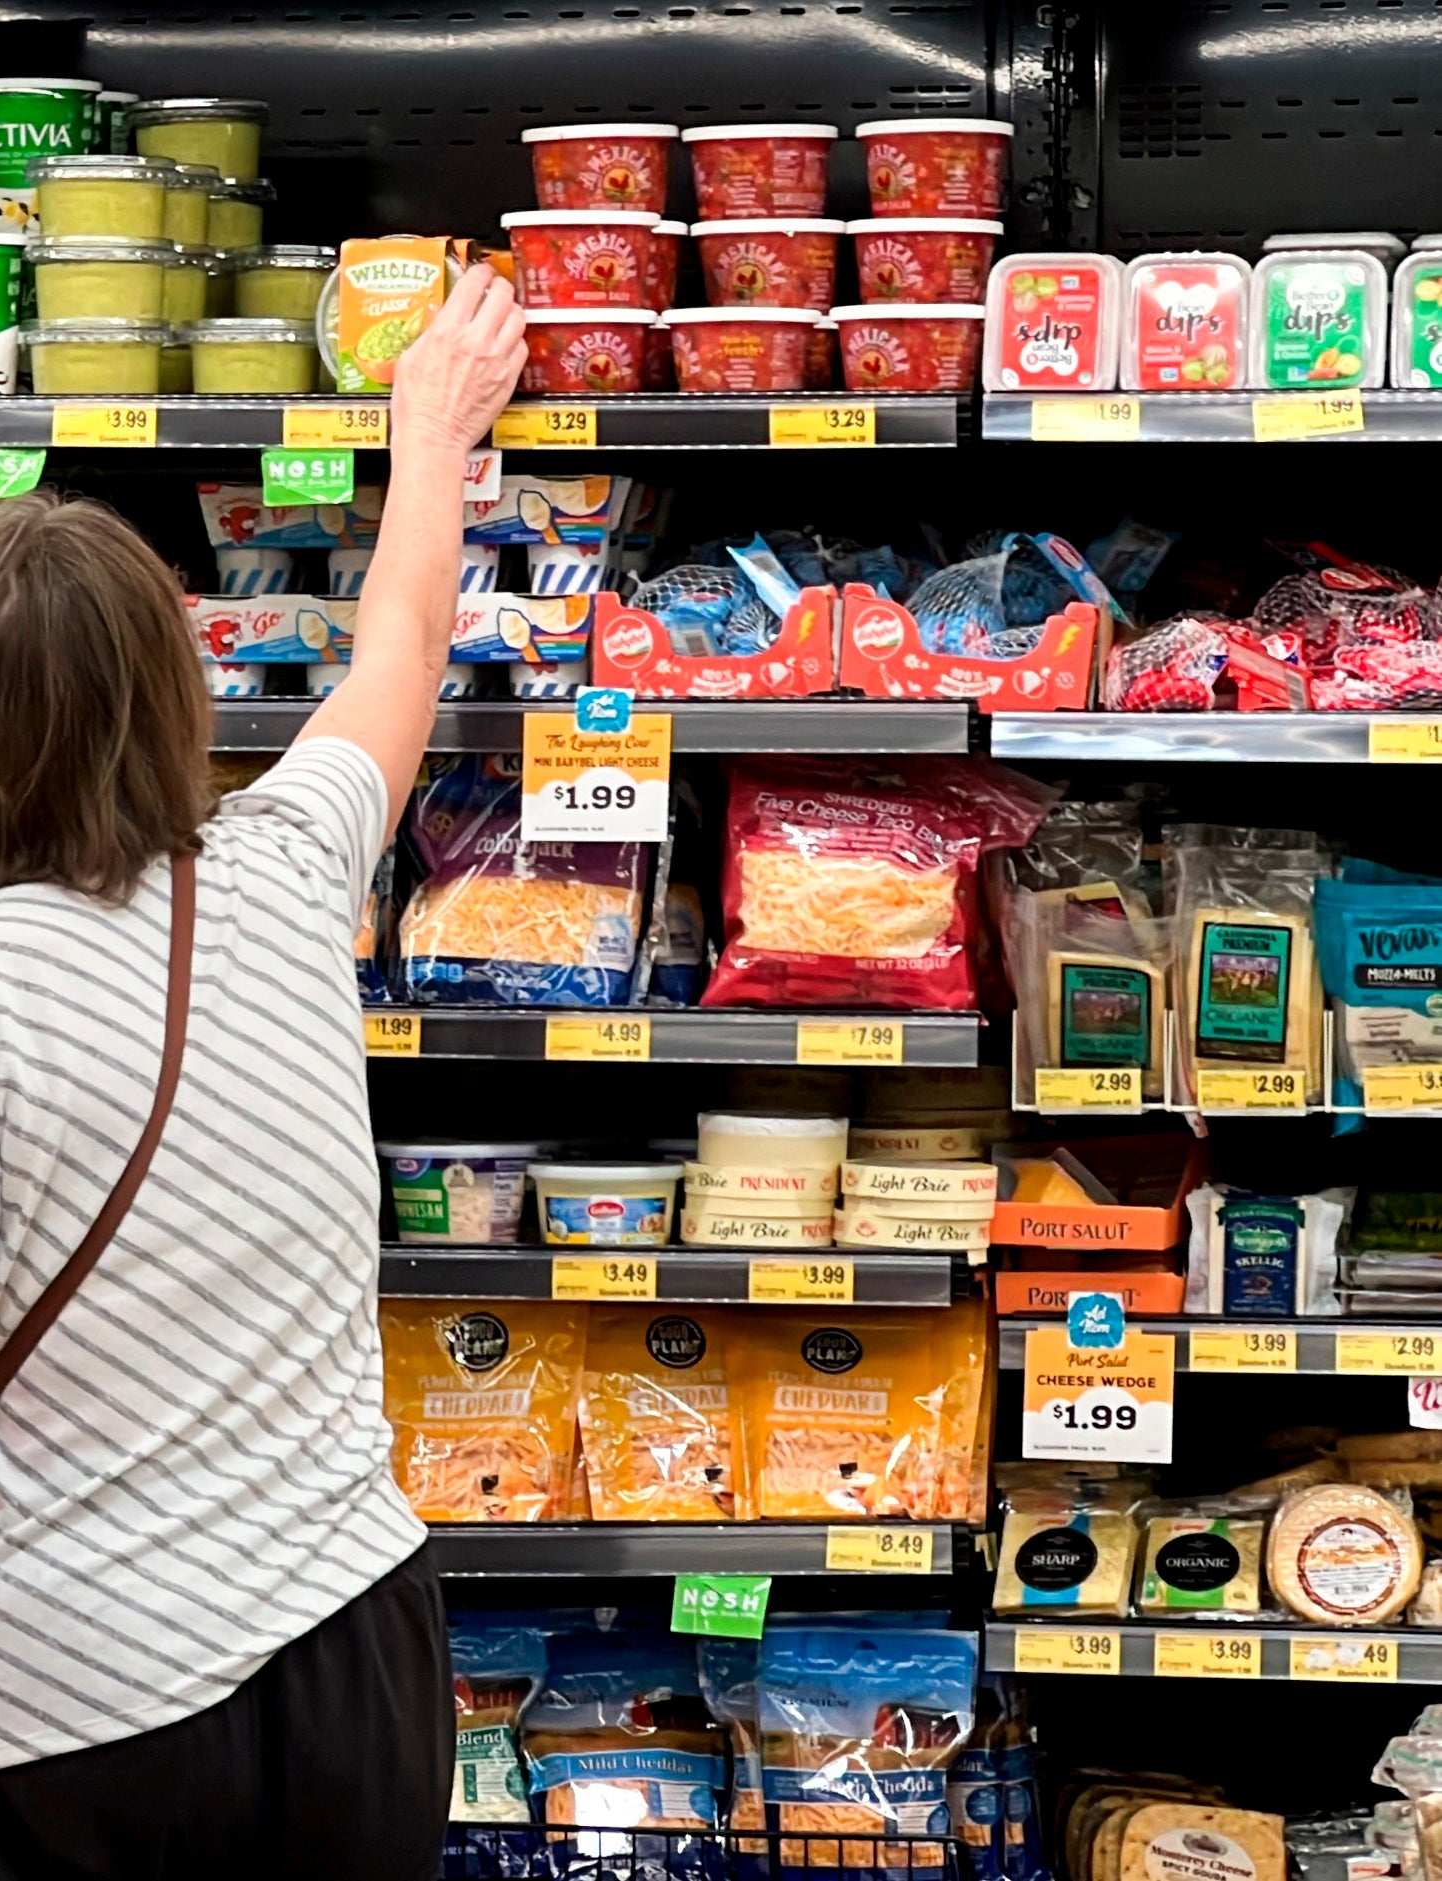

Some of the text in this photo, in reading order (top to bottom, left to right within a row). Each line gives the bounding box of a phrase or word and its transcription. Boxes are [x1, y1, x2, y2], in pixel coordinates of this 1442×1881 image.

[350, 262, 438, 283] WHOLLY
[1156, 305, 1224, 343] dips
[1284, 304, 1357, 342] dips
[268, 459, 347, 478] NOSH
[534, 757, 661, 768] MINI BABYBEL LIGHT CHEESE
[554, 785, 637, 809] $1.99
[823, 792, 914, 817] SHREDDED
[755, 792, 915, 831] Five Cheese Taco
[697, 1171, 728, 1188] Brie
[870, 1175, 951, 1194] Light Brie
[709, 1221, 790, 1240] Light Brie
[893, 1223, 971, 1242] Light Brie
[1020, 1218, 1130, 1241] PORT SALUT
[1234, 1256, 1286, 1269] SKELLIG
[1028, 1287, 1068, 1306] POR
[1037, 1375, 1158, 1388] CHEESE WEDGE
[1053, 1404, 1138, 1430] $1.99
[1031, 1552, 1081, 1567] SHARP
[1165, 1555, 1231, 1570] ORGANIC
[683, 1588, 759, 1611] NOSH
[456, 1728, 506, 1748] Blend
[578, 1757, 618, 1773] Mild
[1151, 1844, 1254, 1879] Monterey Cheese
